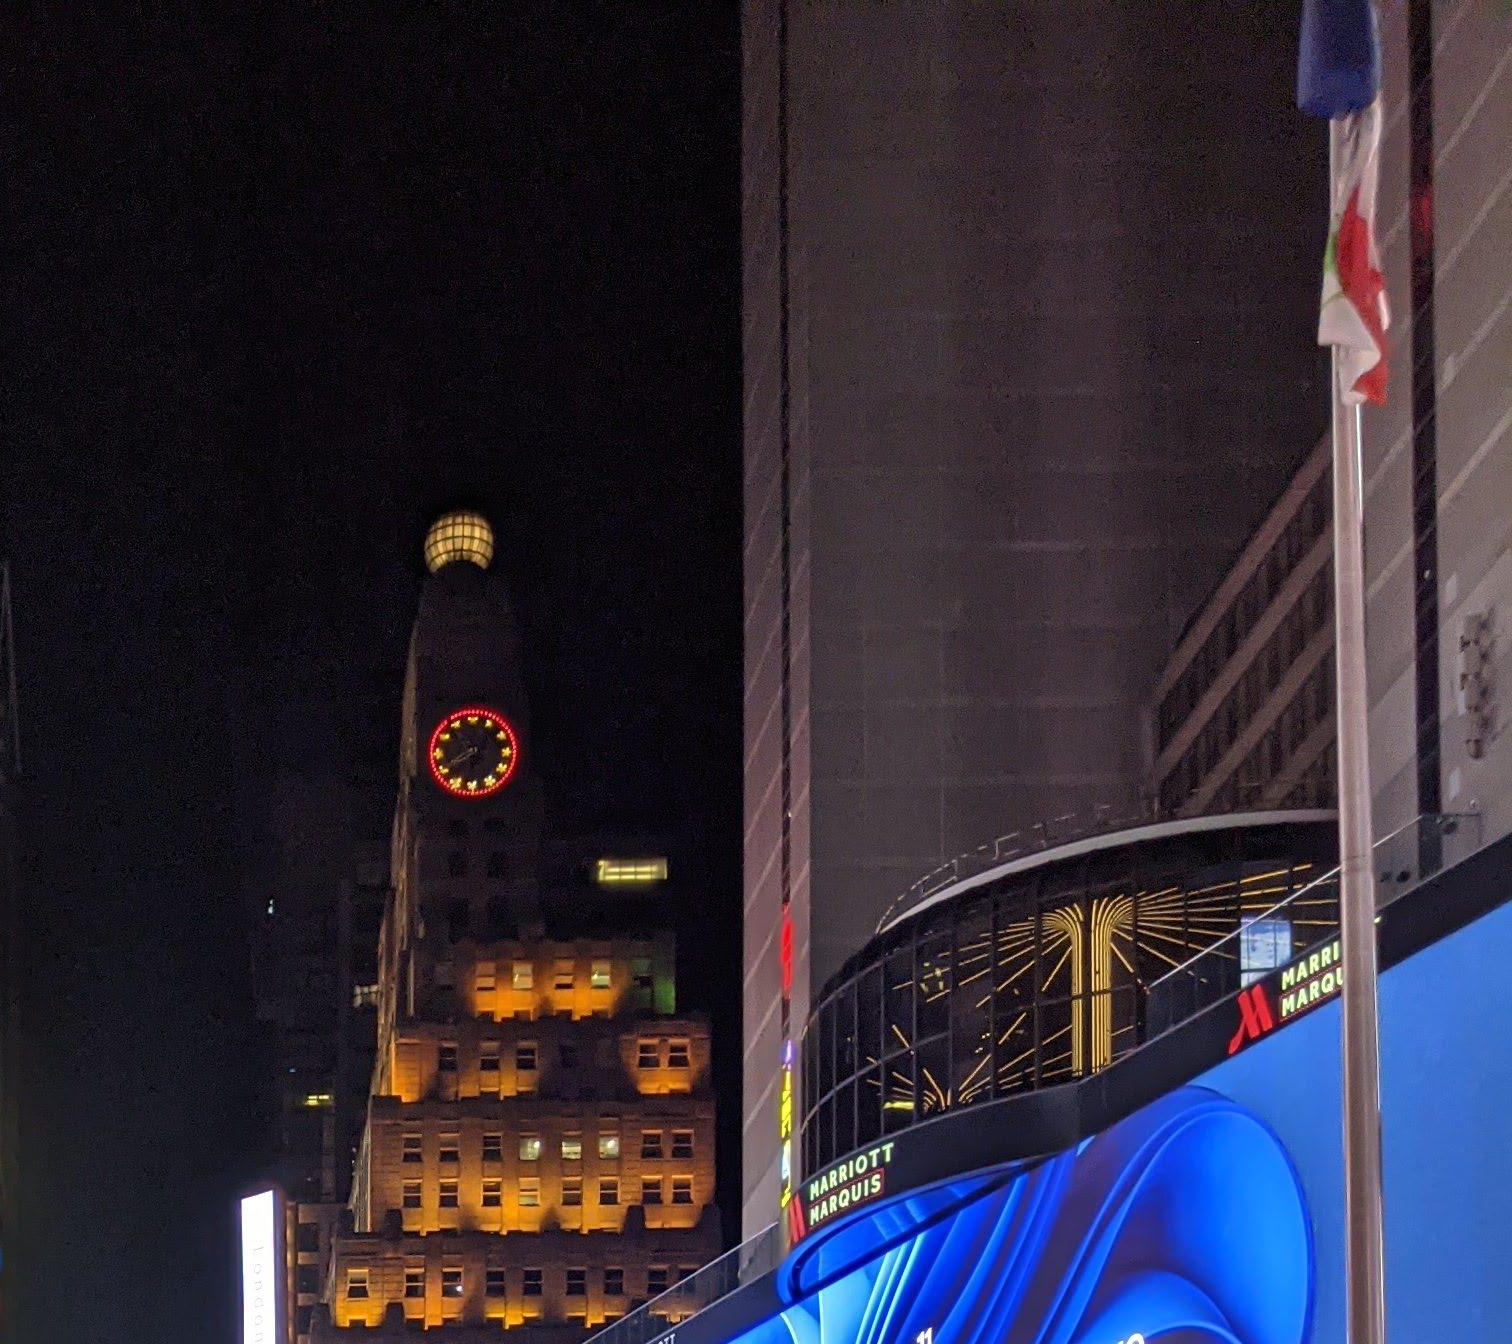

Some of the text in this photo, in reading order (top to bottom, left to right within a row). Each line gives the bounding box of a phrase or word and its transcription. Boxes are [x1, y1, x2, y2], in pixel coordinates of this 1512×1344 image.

[1281, 941, 1339, 991] MARRI
[1281, 967, 1344, 1017] MARQU
[809, 1143, 895, 1201] MARRIOTT
[809, 1174, 881, 1227] MARQUIS
